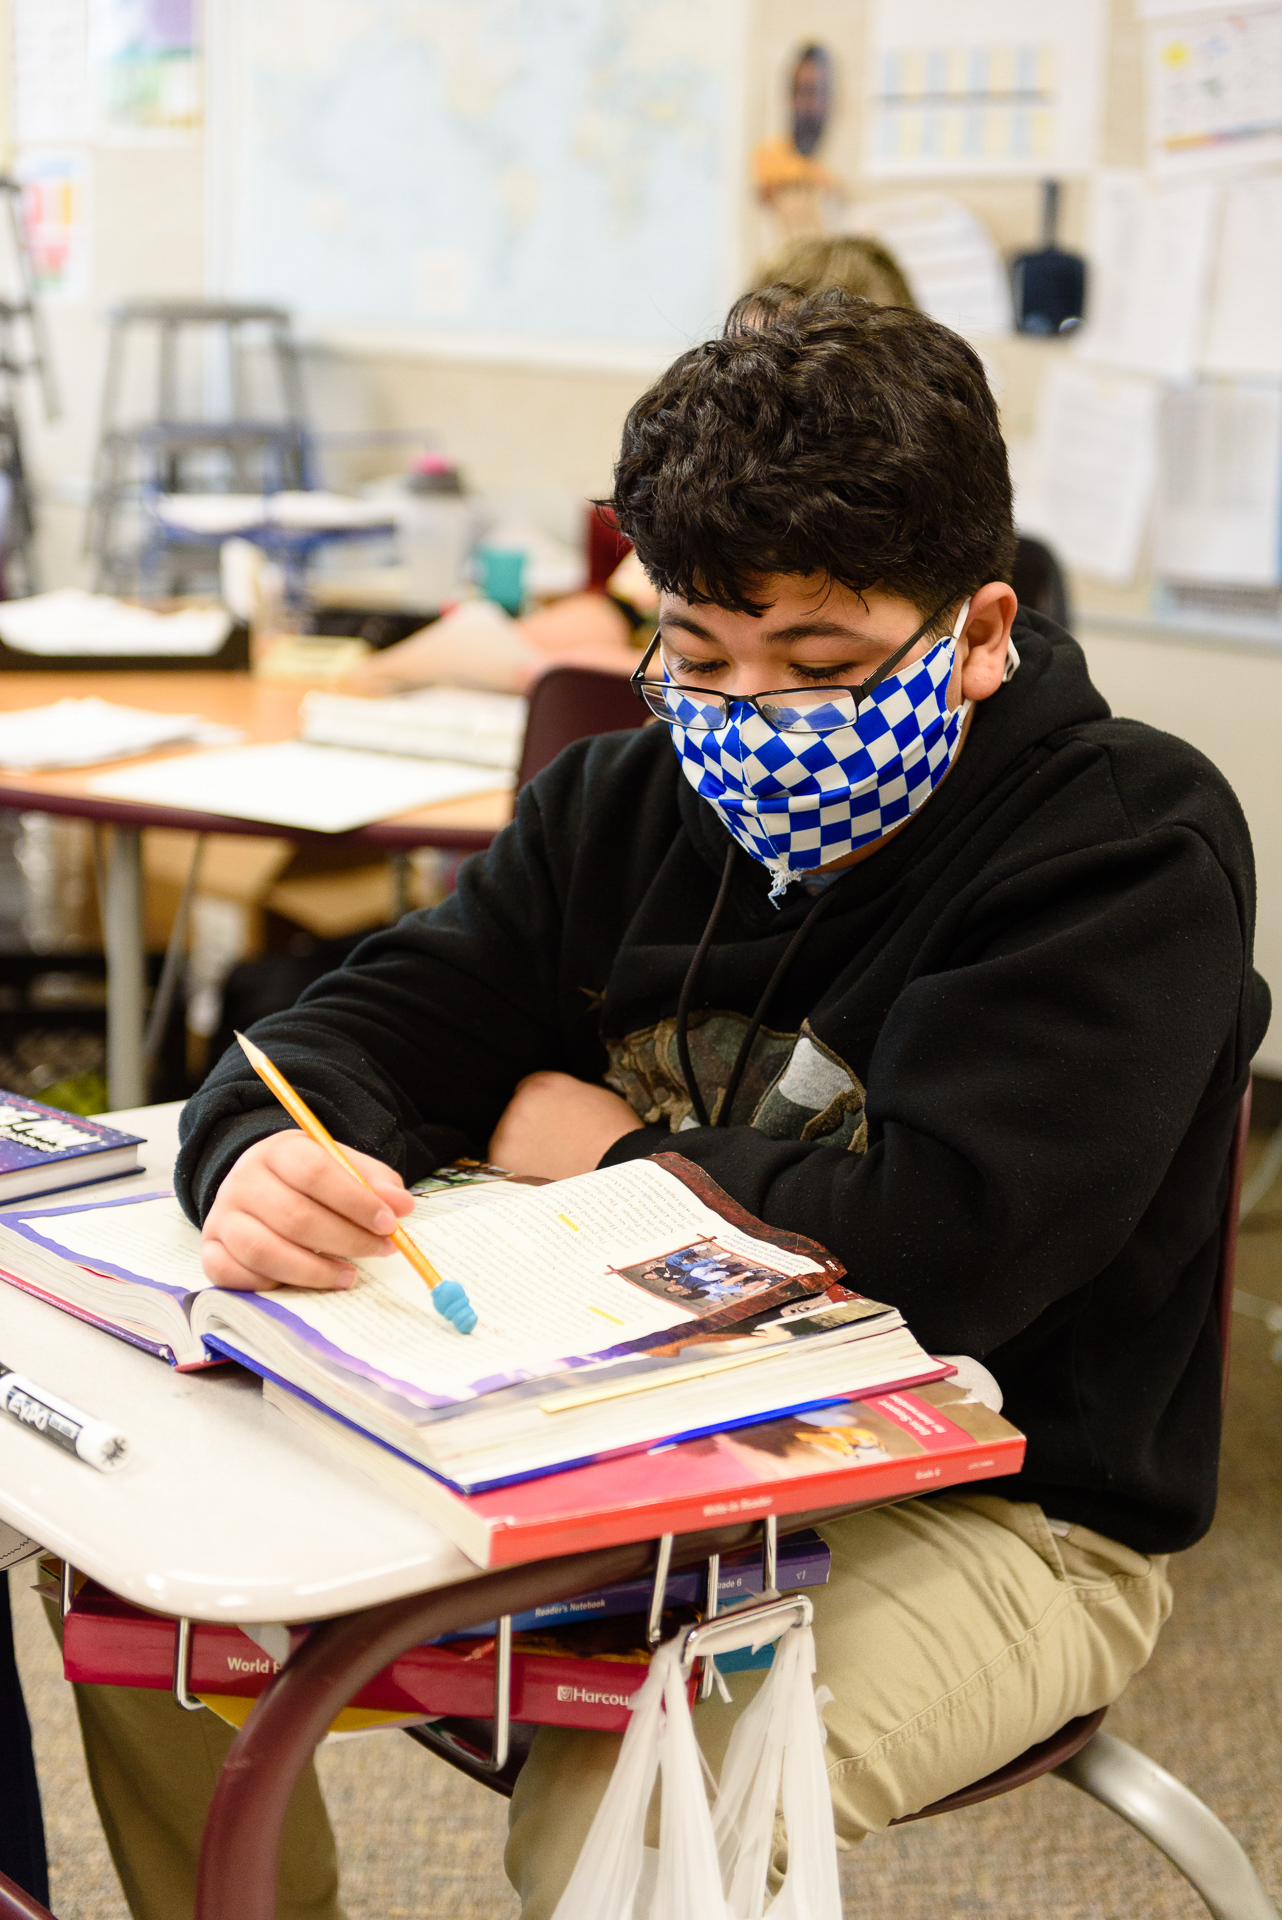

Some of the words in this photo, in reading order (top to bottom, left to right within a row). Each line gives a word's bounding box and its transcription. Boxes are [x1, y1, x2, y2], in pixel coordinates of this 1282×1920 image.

[8, 1393, 49, 1431] EXPO
[740, 1496, 772, 1511] Reader
[736, 1578, 742, 1587] 6
[535, 1604, 568, 1618] Reader's
[569, 1599, 606, 1612] Notebook
[227, 1656, 270, 1674] World
[573, 1687, 628, 1706] Harcou
